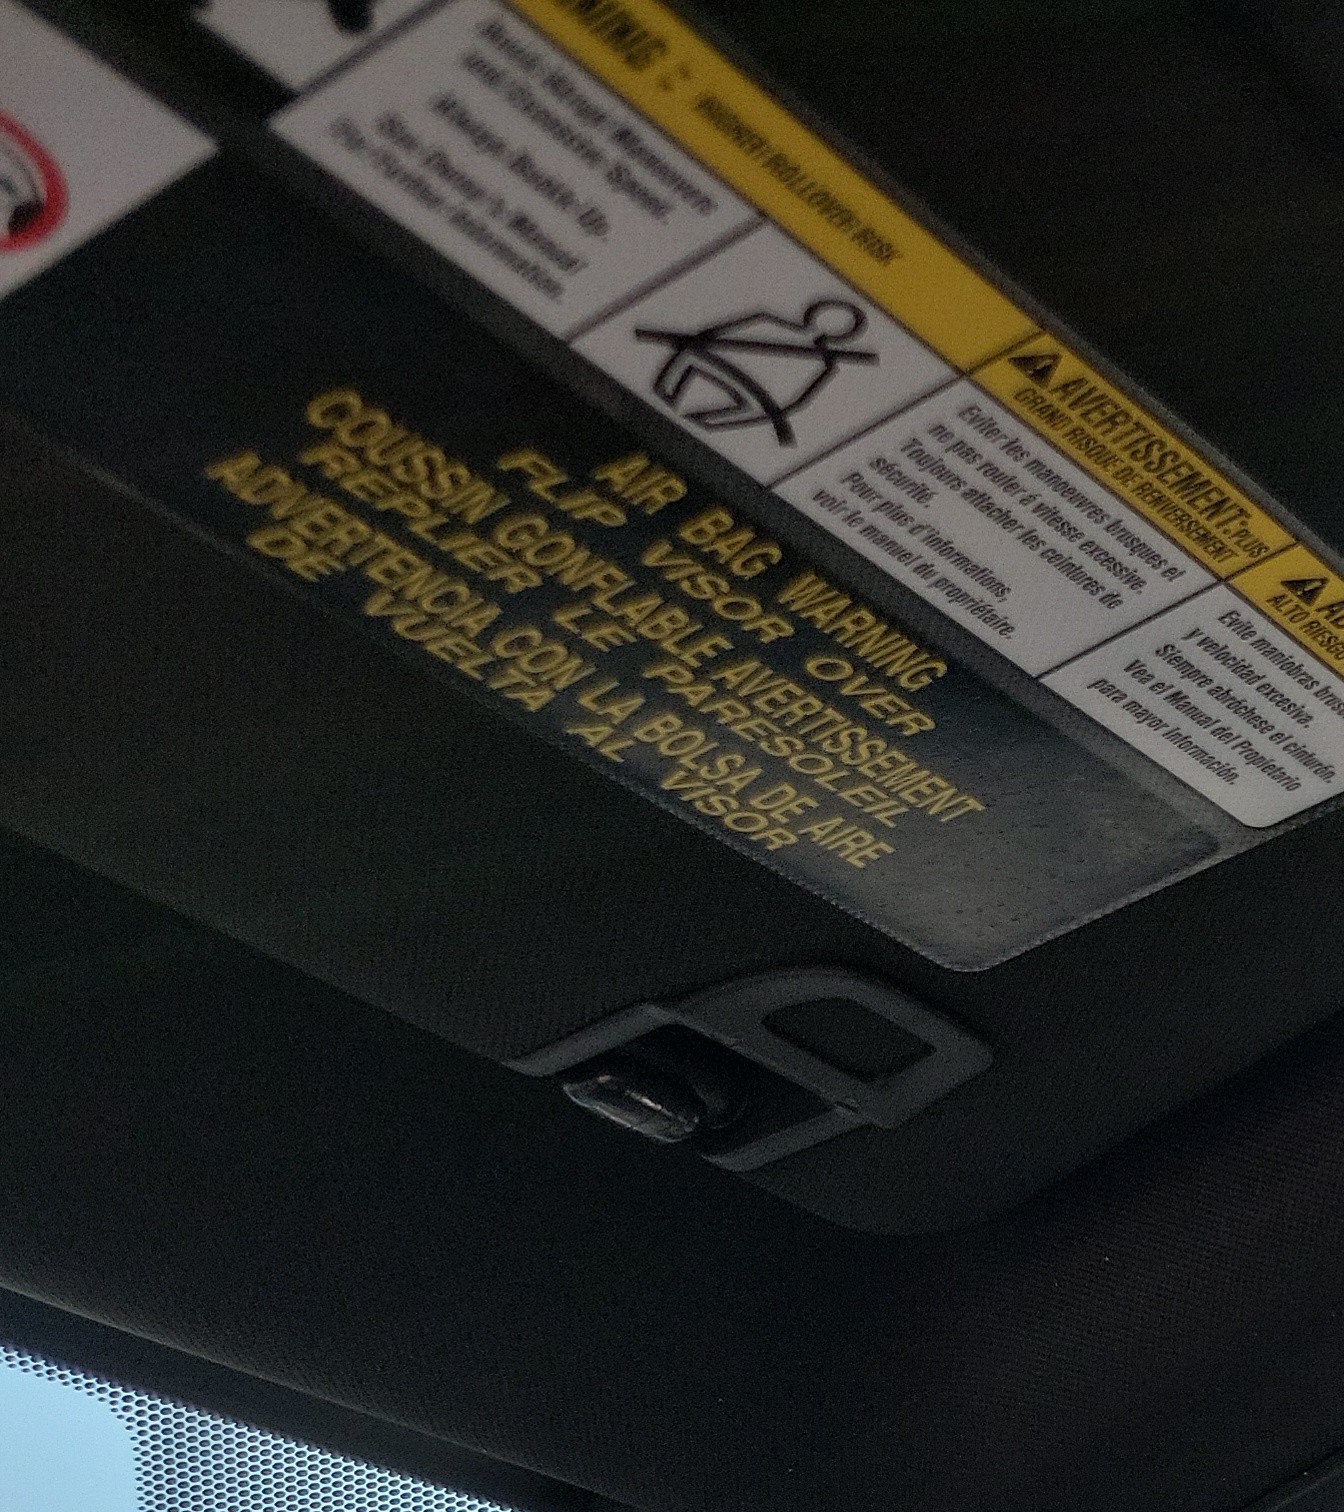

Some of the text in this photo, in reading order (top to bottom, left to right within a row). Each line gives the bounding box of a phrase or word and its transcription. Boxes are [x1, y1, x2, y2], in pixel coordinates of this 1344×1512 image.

[808, 487, 849, 515] voir
[839, 509, 867, 527] le
[857, 522, 923, 567] manuel
[909, 560, 942, 580] du
[836, 470, 889, 505] Pour
[869, 497, 920, 530] plus
[890, 437, 1128, 610] Toujours attacher les ceintures de
[925, 422, 958, 444] ne
[942, 438, 985, 467] pas
[973, 458, 1031, 499] rouler
[1027, 500, 1089, 543] vitesse
[1075, 537, 1152, 596] excessive.
[997, 436, 1036, 463] les
[1021, 457, 1114, 525] manoeuvres
[1097, 518, 1174, 572] brusques
[1159, 563, 1188, 582] et
[1010, 385, 1241, 566] GRAND RISQUE DE RENVERSEMENT
[1045, 373, 1272, 560] AVERTISSEMENT: PLUS
[293, 381, 987, 834] COUSSIN GONFLABLE AVERTISSEMENT
[296, 437, 913, 835] REPLIER LE PARESOLEIL
[488, 442, 943, 743] FLIP VISOR OVER
[588, 446, 959, 696] AIR BAG WARNING
[1215, 609, 1264, 641] Evite
[1245, 635, 1327, 691] maniobras
[1263, 592, 1312, 624] ALTO
[201, 442, 895, 875] ADVERTENCIA CON LA BOLSA DE AIRE
[245, 518, 798, 859] DE VUELTA AL VISOR
[1085, 677, 1131, 706] para
[1116, 699, 1171, 734] mayor
[1120, 659, 1308, 793] Vea el Manual del Propietario
[1147, 642, 1341, 784] Siempre abróchese el cinturón.
[1179, 627, 1320, 728] y velocidad excesiva.
